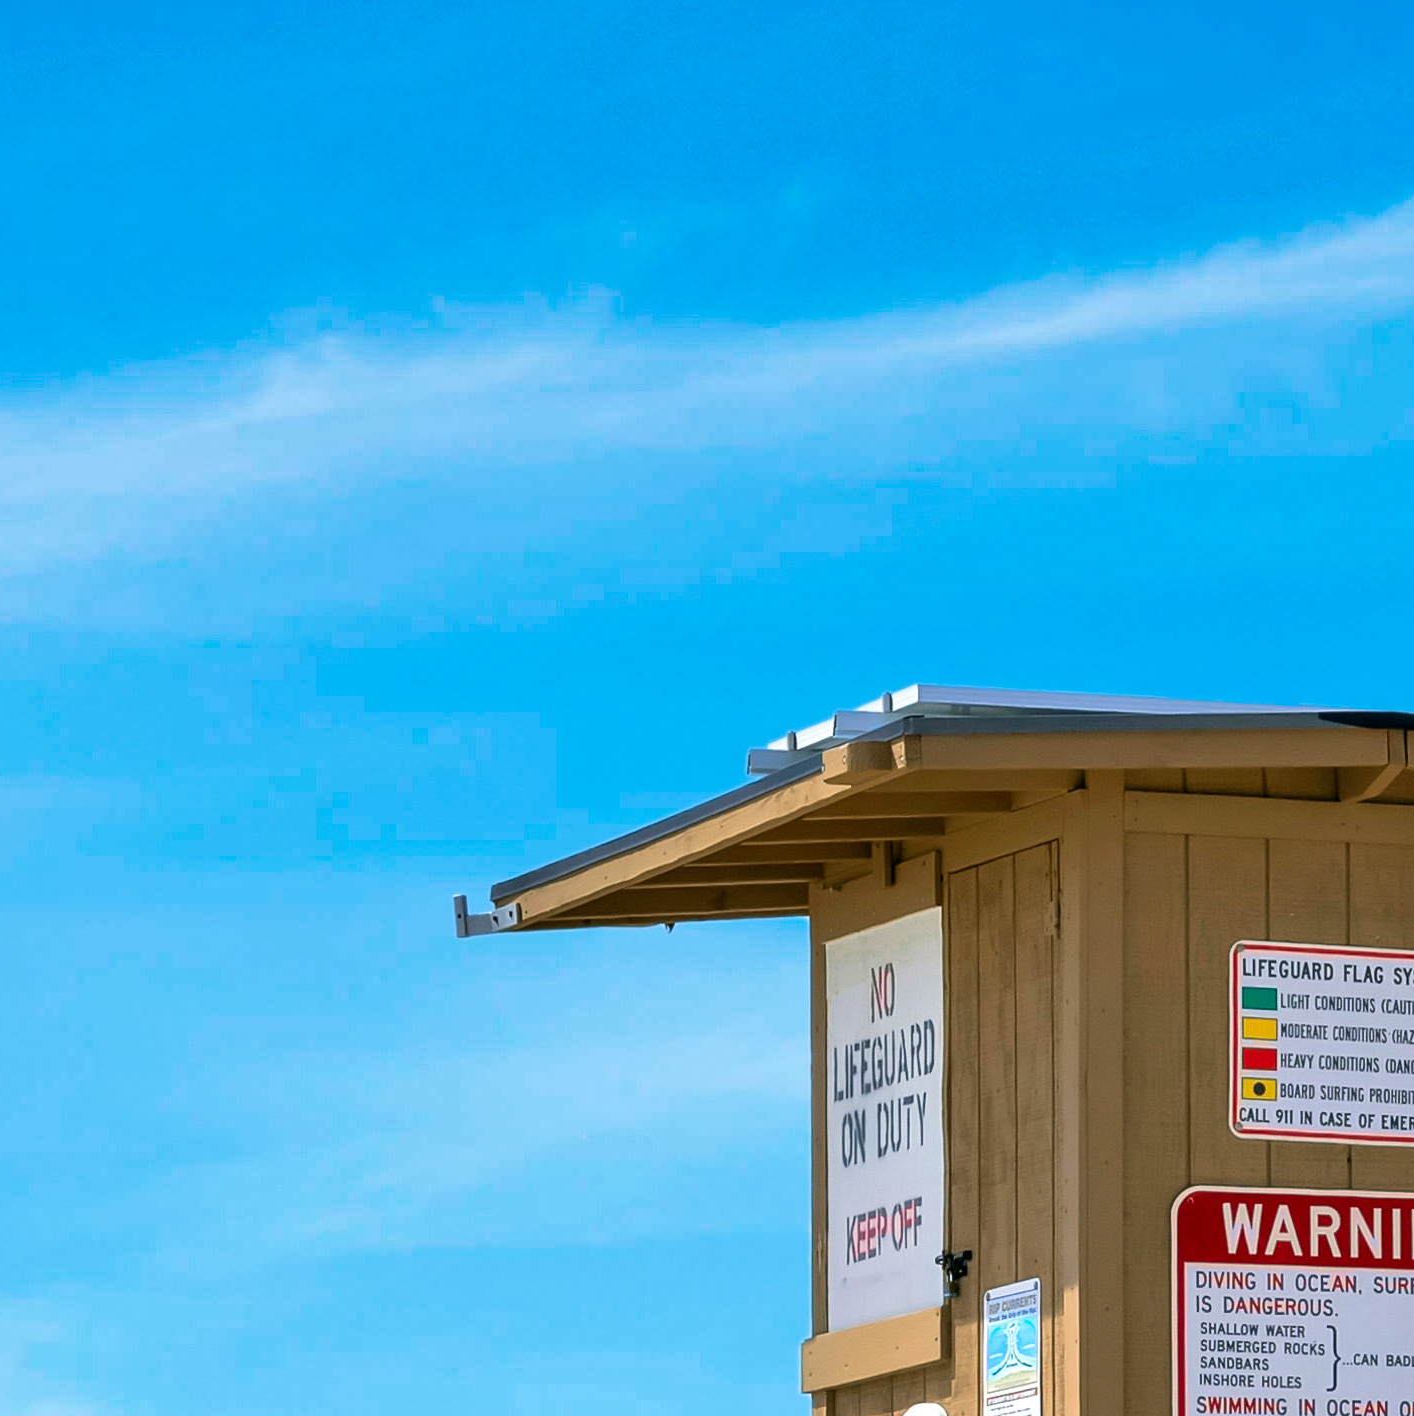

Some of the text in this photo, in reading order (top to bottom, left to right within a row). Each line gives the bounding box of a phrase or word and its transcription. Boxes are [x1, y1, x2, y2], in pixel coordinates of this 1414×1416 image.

[1242, 958, 1333, 981] LIFEGUARD
[1343, 964, 1384, 984] FLAG
[871, 963, 895, 1023] NO
[1280, 993, 1310, 1010] LIGHT
[1315, 996, 1375, 1013] CONDITIONS
[1281, 1023, 1328, 1040] MODERATE
[1333, 1026, 1387, 1043] CONDITIONS
[833, 1019, 935, 1102] LIFEGUARD
[1280, 1053, 1313, 1070] HEAVY
[1319, 1056, 1379, 1073] CONDITIONS
[1280, 1084, 1315, 1099] BOARD
[1320, 1086, 1364, 1102] SURFING
[1239, 1108, 1269, 1123] CALL
[1276, 1110, 1293, 1124] 911
[1300, 1111, 1313, 1125] IN
[1319, 1112, 1351, 1128] CASE
[1359, 1114, 1375, 1128] OF
[842, 1092, 927, 1168] ON DUTY
[846, 1197, 922, 1265] KEEP OFF
[1195, 1271, 1256, 1290] DIVING
[1267, 1273, 1284, 1291] IN
[1295, 1274, 1362, 1295] OCEAN,
[1195, 1296, 1339, 1317] IS DANGEROUS.
[1200, 1322, 1305, 1338] SHALLOW WATER
[1200, 1340, 1325, 1356] SUBMERGED ROCKS
[1200, 1357, 1269, 1371] SANDBARS
[1199, 1373, 1302, 1389] INSHORE HOLES
[1196, 1397, 1287, 1416] SWIMMING
[1299, 1399, 1315, 1416] IN
